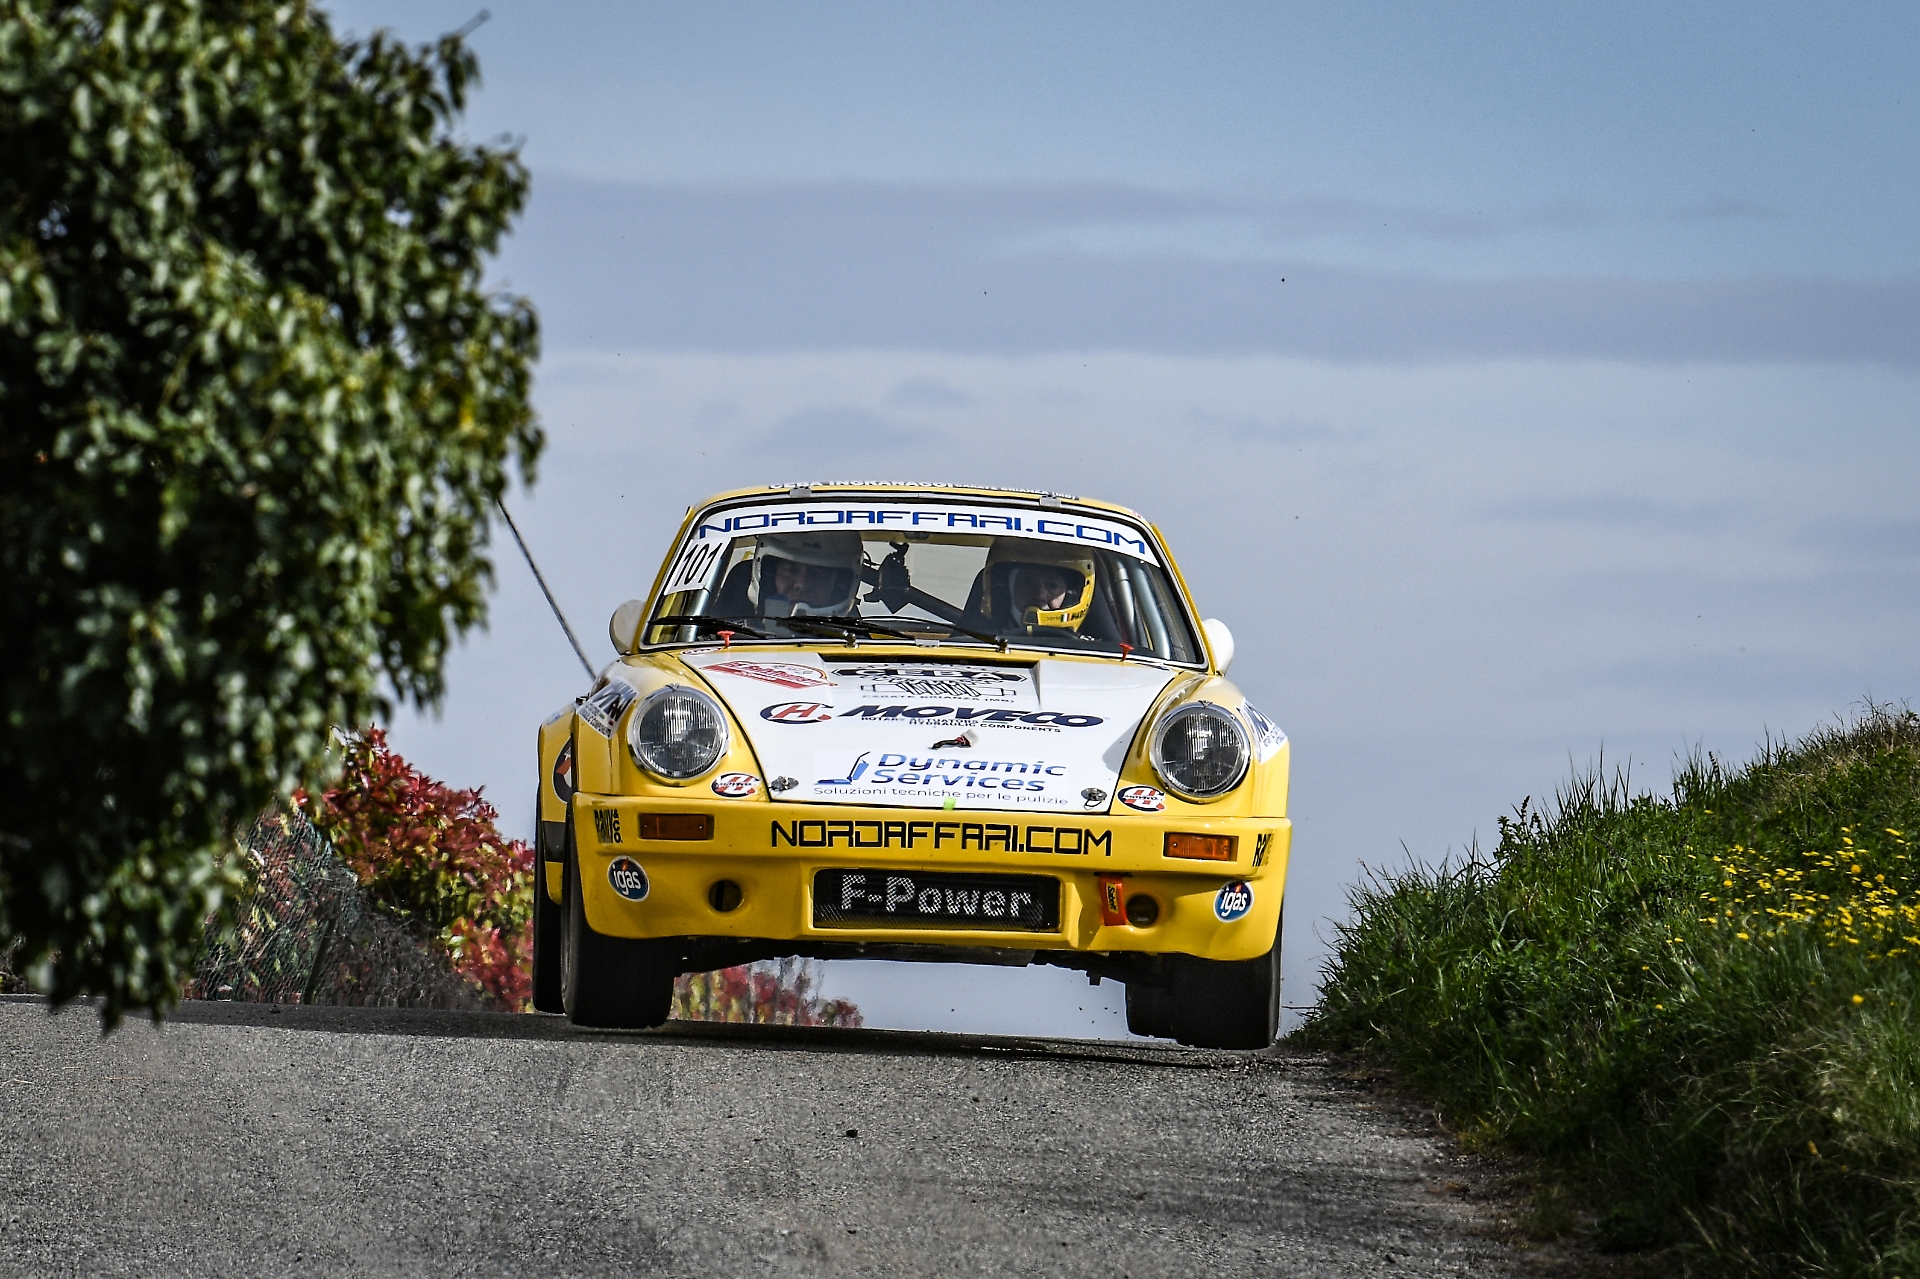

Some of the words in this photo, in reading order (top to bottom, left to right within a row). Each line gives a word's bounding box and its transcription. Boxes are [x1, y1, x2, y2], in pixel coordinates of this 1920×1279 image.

[699, 510, 1145, 555] NORDAFFARI.COM
[674, 542, 723, 587] 101
[855, 668, 1005, 682] CEBA
[837, 705, 1105, 728] MOVECO
[979, 723, 1062, 733] COMPONENTS
[878, 753, 1067, 776] Dynamic
[870, 769, 1046, 792] Services
[814, 787, 886, 796] Soluzioni
[891, 788, 962, 798] tecniche
[966, 792, 993, 800] per
[998, 792, 1011, 801] le
[1016, 795, 1068, 806] pulizie
[771, 820, 1113, 857] NORDAFFARI.COM
[612, 863, 642, 896] igas
[841, 874, 1031, 917] F-Power
[1220, 886, 1248, 918] igas
